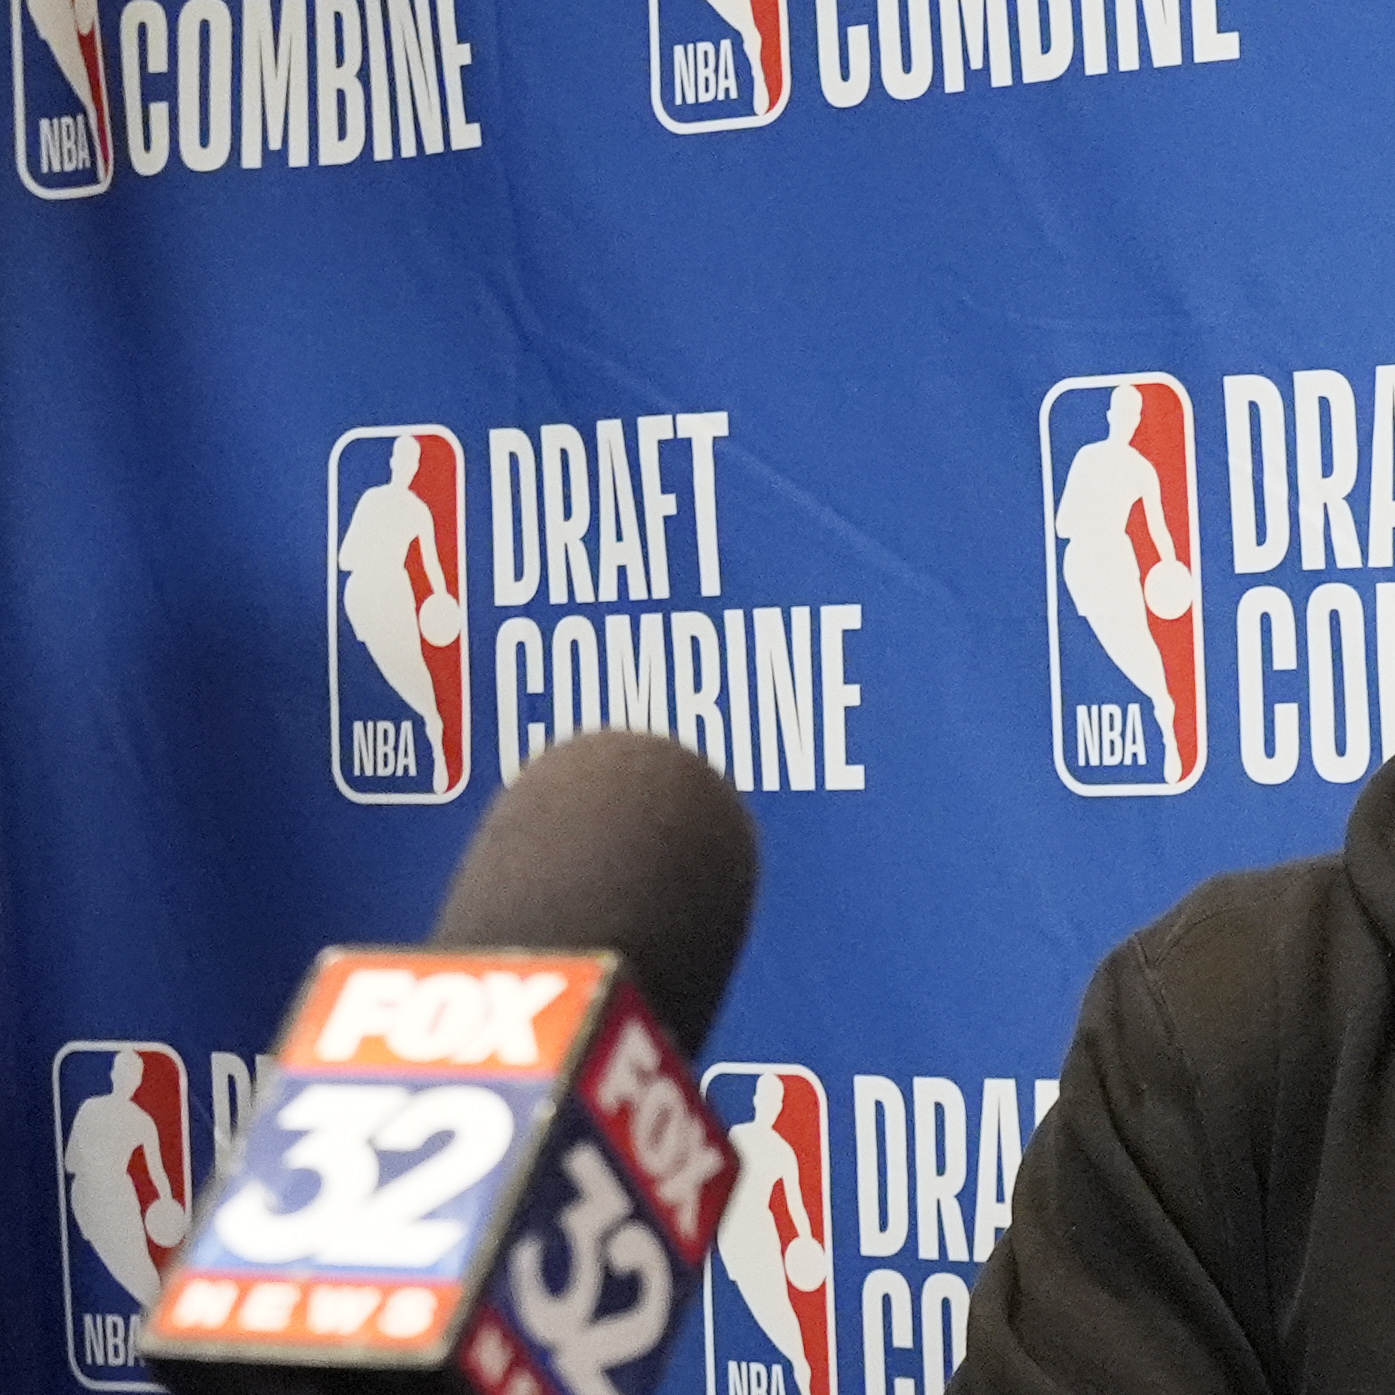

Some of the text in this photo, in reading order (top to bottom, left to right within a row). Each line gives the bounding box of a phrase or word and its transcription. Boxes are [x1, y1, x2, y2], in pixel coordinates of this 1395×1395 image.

[120, 0, 483, 176] COMBINE
[673, 39, 738, 106] NBA
[39, 115, 92, 174] NBA
[489, 412, 729, 607] DRAFT
[353, 720, 417, 777] NBA
[495, 604, 865, 791] COMBINE
[1077, 705, 1147, 767] NBA
[316, 968, 570, 1065] FOX
[214, 1083, 515, 1268] 32
[853, 1074, 1061, 1263] DRA
